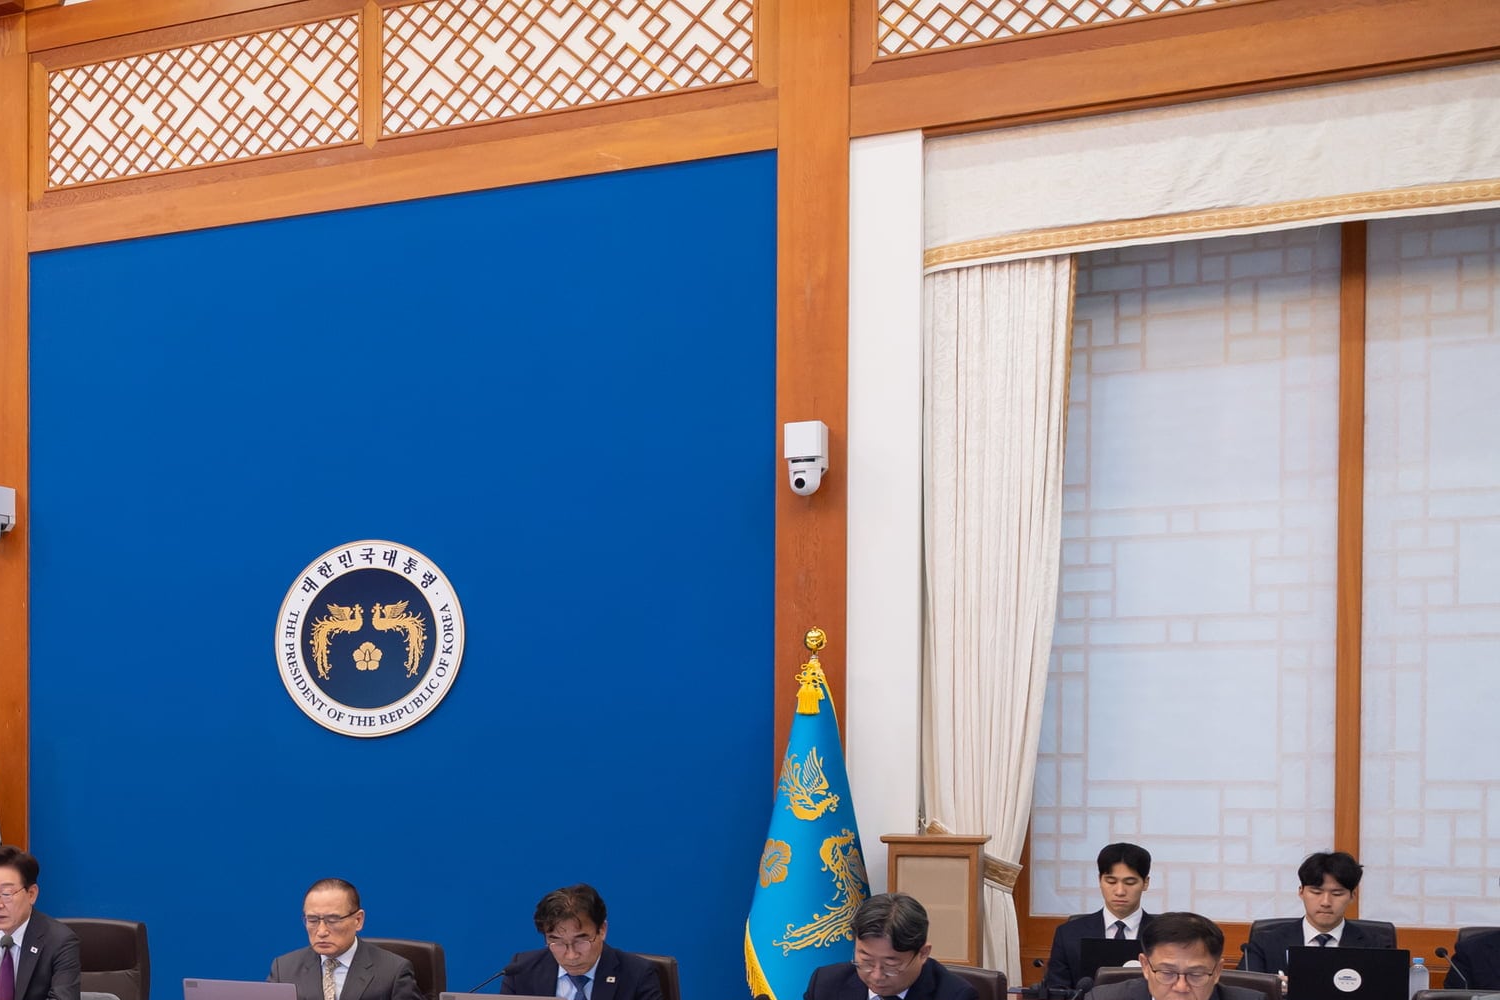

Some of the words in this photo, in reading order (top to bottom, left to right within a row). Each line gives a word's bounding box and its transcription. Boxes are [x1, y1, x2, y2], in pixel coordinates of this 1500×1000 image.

[302, 547, 439, 594] 대한민국대통령
[285, 610, 301, 640] THE
[439, 603, 455, 655] KOREA
[285, 643, 328, 712] PRESIDENT
[435, 658, 451, 678] OF
[327, 707, 346, 726] OF
[348, 714, 377, 727] THE
[379, 678, 441, 726] REPUBLIC
